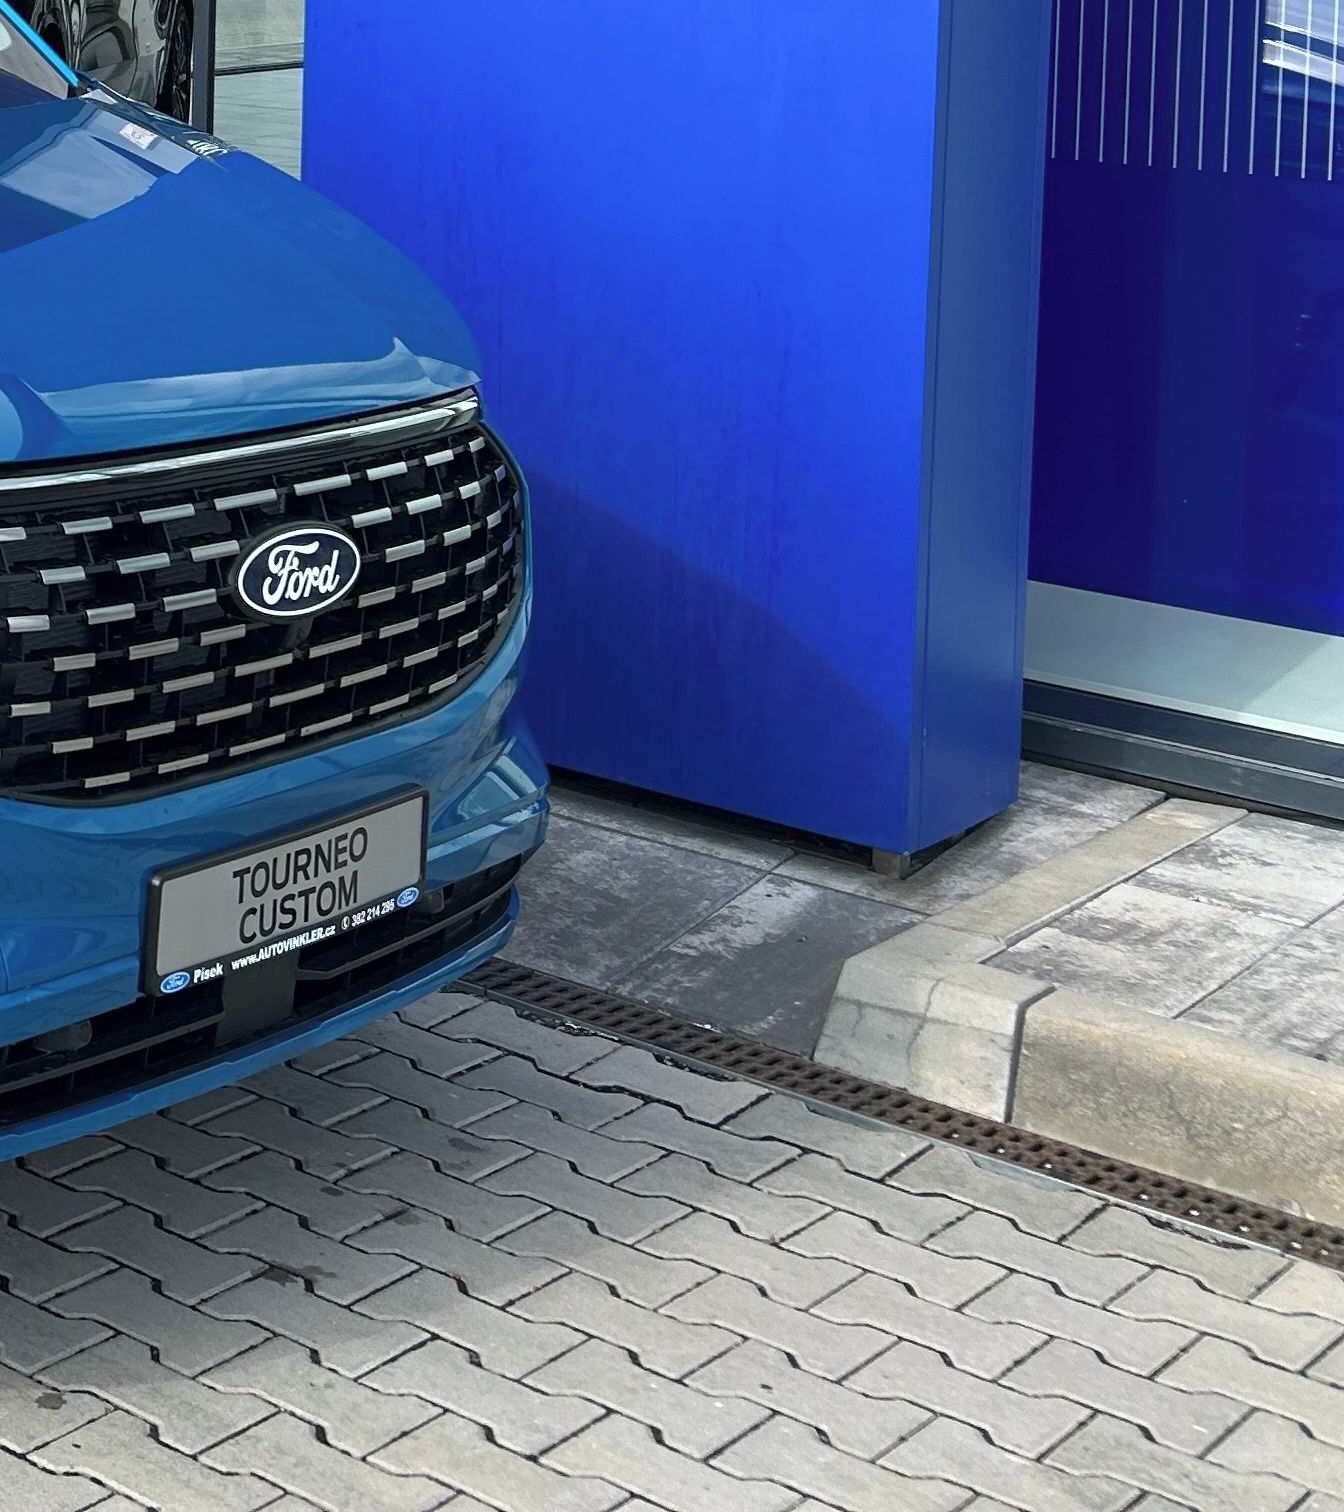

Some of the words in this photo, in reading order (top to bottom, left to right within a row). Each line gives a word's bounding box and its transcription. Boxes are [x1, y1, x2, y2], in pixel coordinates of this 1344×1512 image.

[262, 540, 341, 606] Ford
[232, 826, 369, 905] TOURNEO
[239, 870, 359, 944] CUSTOM
[231, 924, 336, 971] www.AUTOVINKLER.cz
